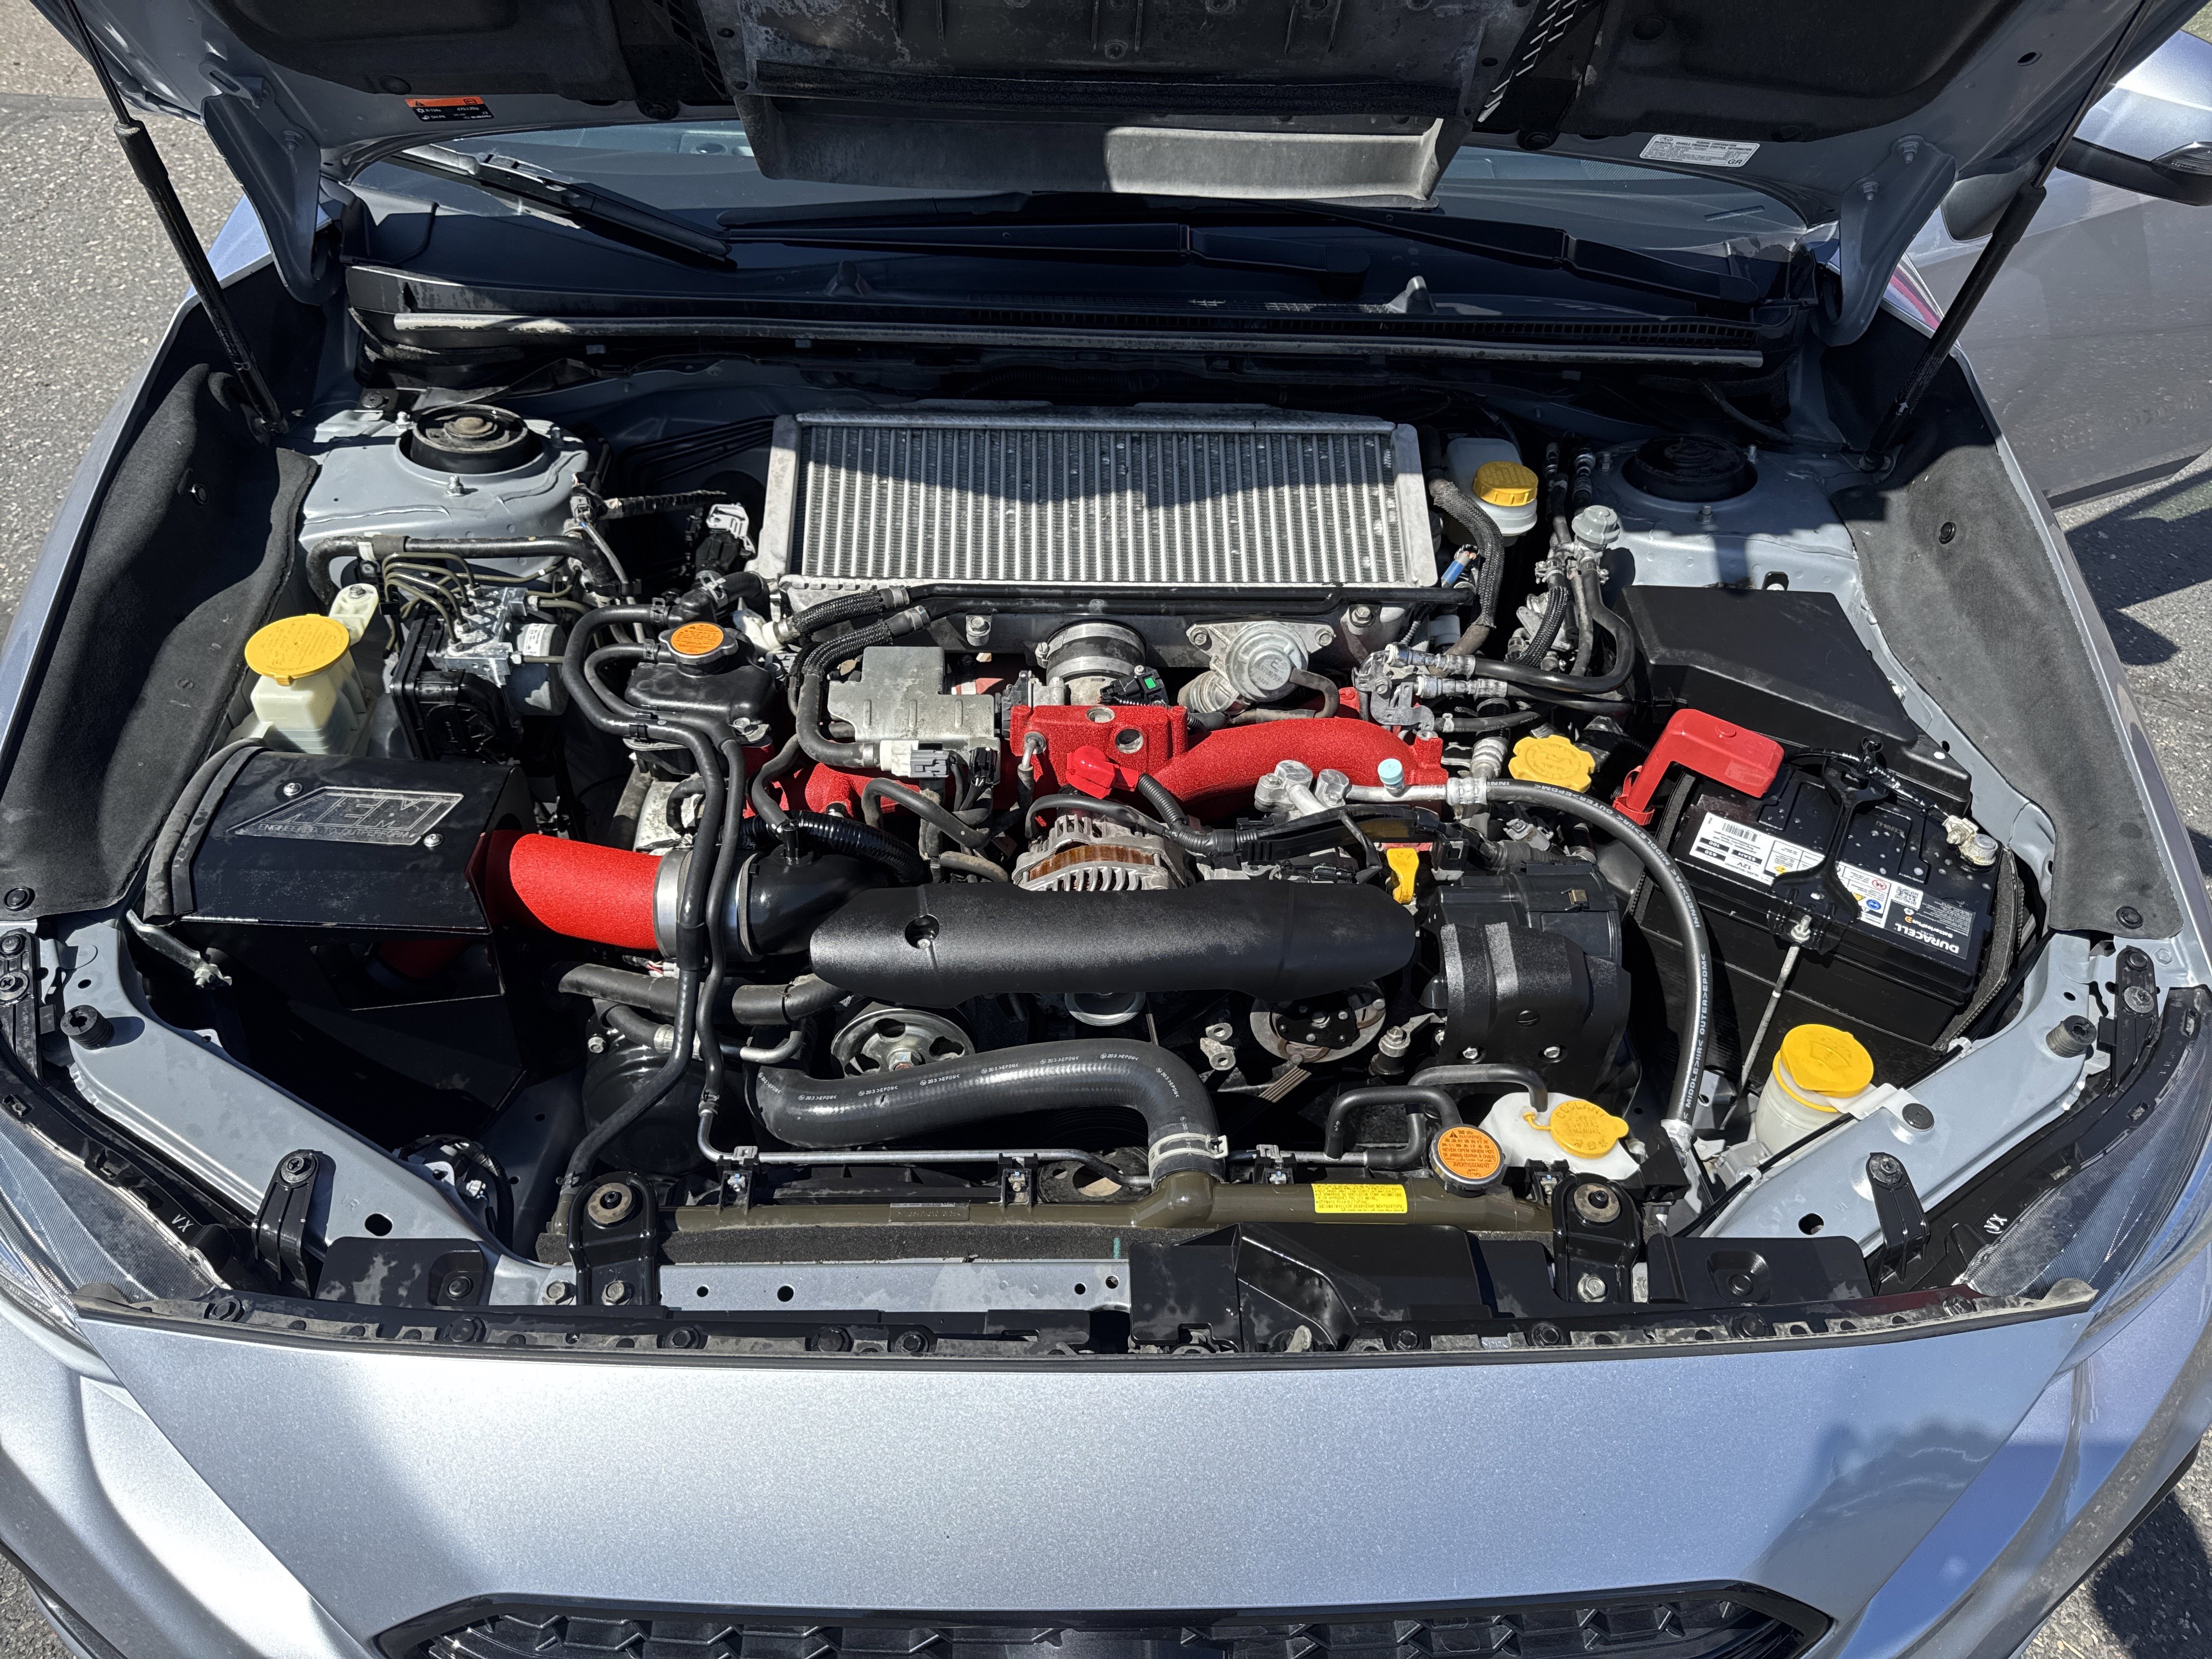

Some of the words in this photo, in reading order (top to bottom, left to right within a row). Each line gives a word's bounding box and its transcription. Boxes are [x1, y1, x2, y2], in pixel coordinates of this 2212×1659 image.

[259, 792, 442, 831] AEM
[257, 823, 317, 833] ENGINEERED
[323, 827, 337, 836] TO
[1737, 862, 1751, 870] 12V
[1894, 923, 1960, 953] DURACELL
[1555, 1102, 1605, 1119] COOLANT
